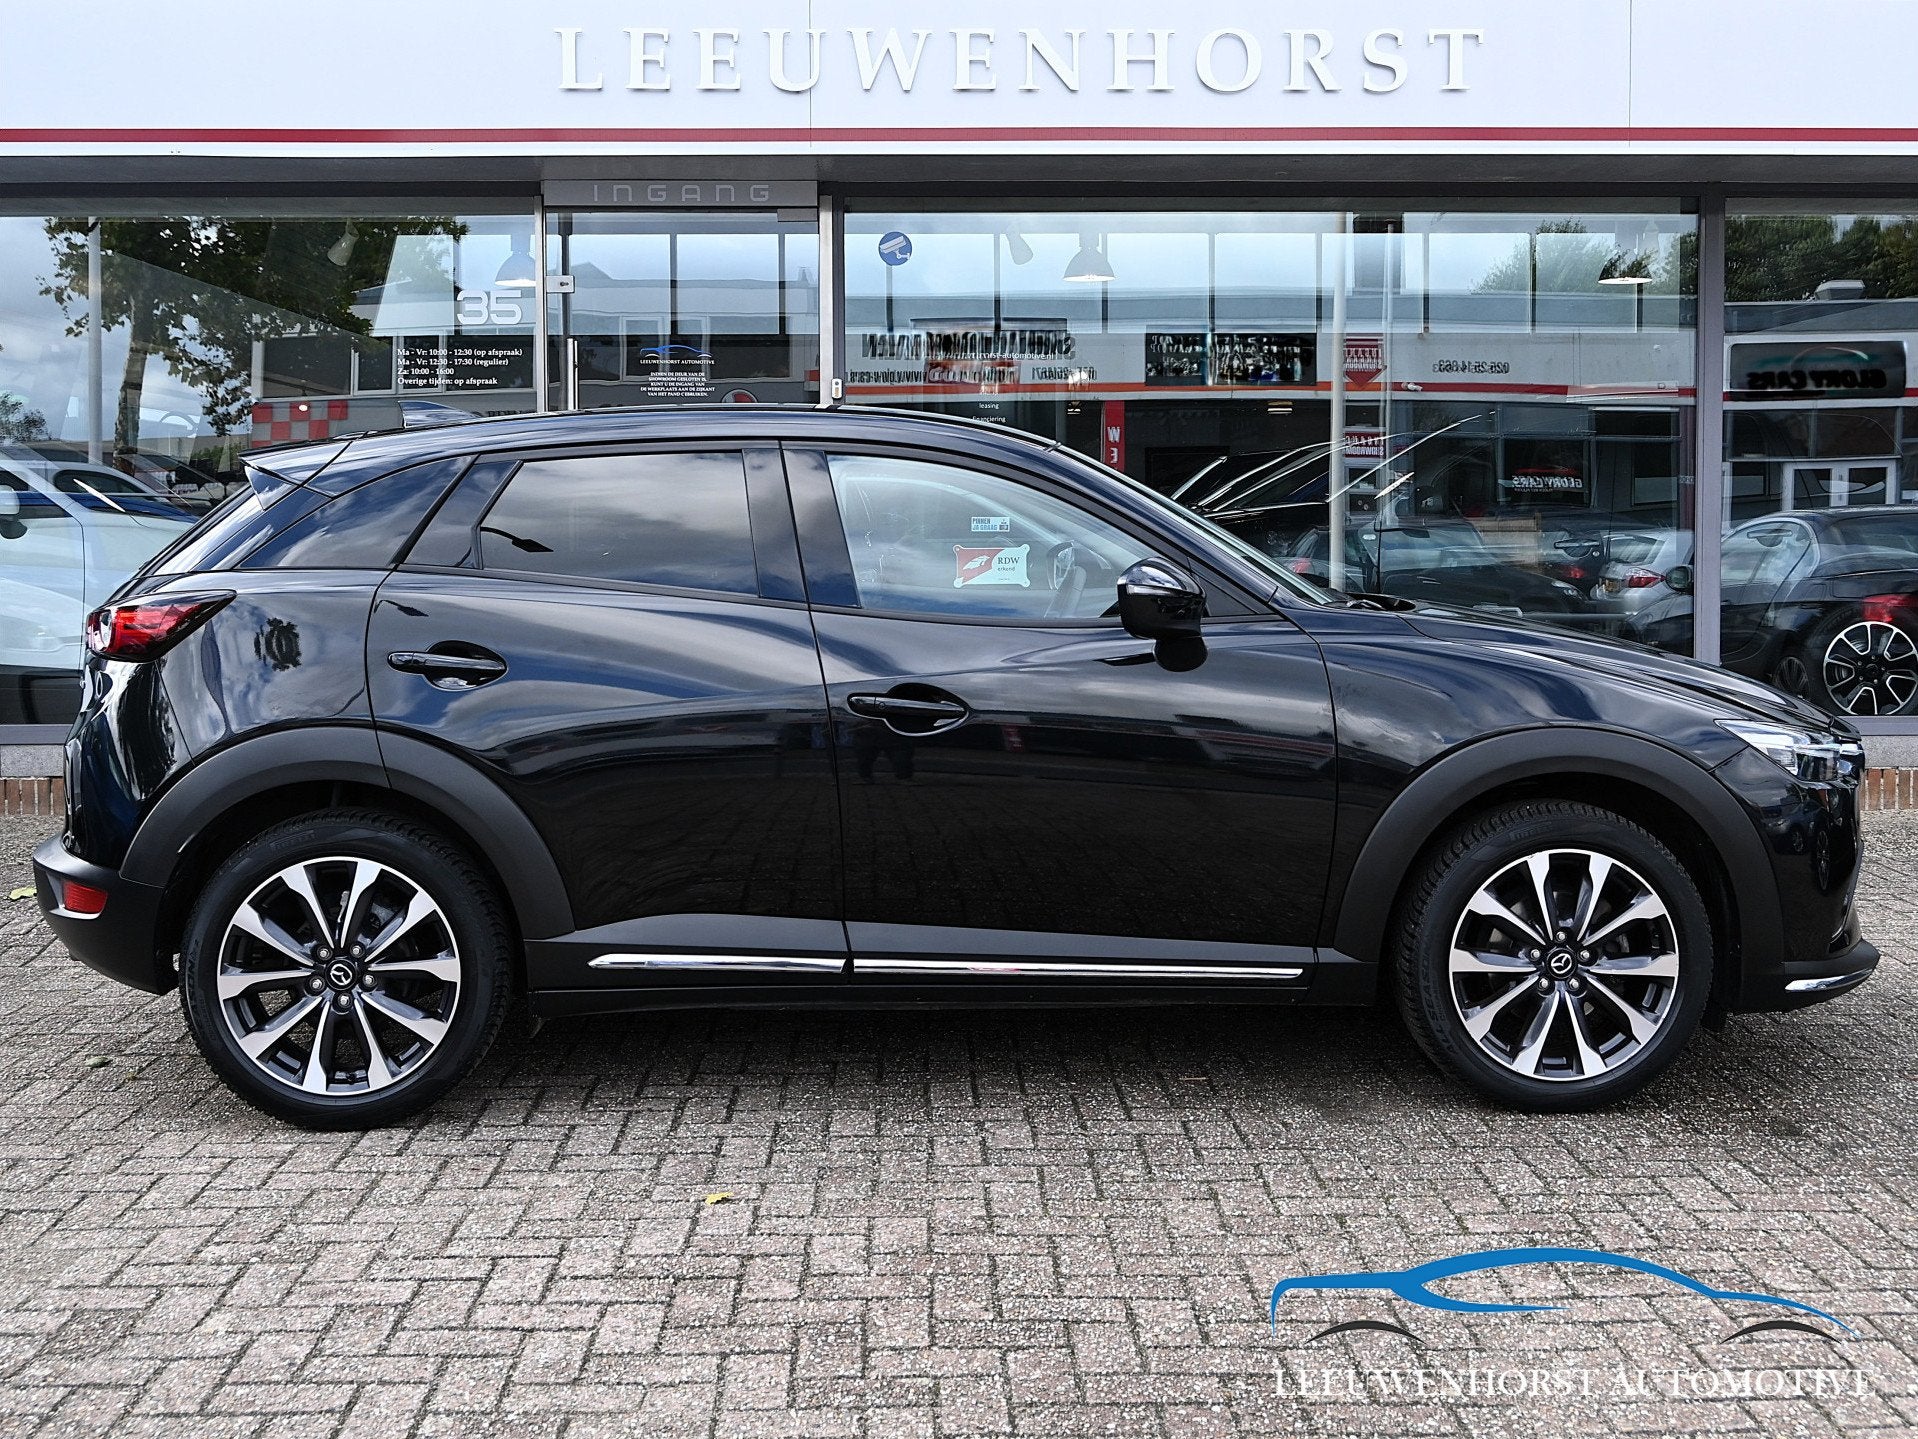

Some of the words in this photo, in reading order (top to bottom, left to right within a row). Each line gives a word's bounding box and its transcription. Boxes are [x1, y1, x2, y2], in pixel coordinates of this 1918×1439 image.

[553, 27, 1485, 93] LEEUWENHORST
[593, 184, 770, 202] INGANG
[457, 290, 522, 325] 35
[473, 349, 487, 358] (op
[487, 349, 523, 358] afspraak)
[397, 358, 410, 366] Ma
[416, 358, 428, 366] Vr:
[429, 358, 448, 366] 12:30
[453, 358, 473, 366] 17:30
[473, 358, 509, 367] (regulier)
[397, 378, 427, 386] Overige
[428, 378, 453, 386] tijden:
[465, 377, 498, 386] afspraak
[979, 402, 1000, 412] leasing
[997, 556, 1020, 565] RDW
